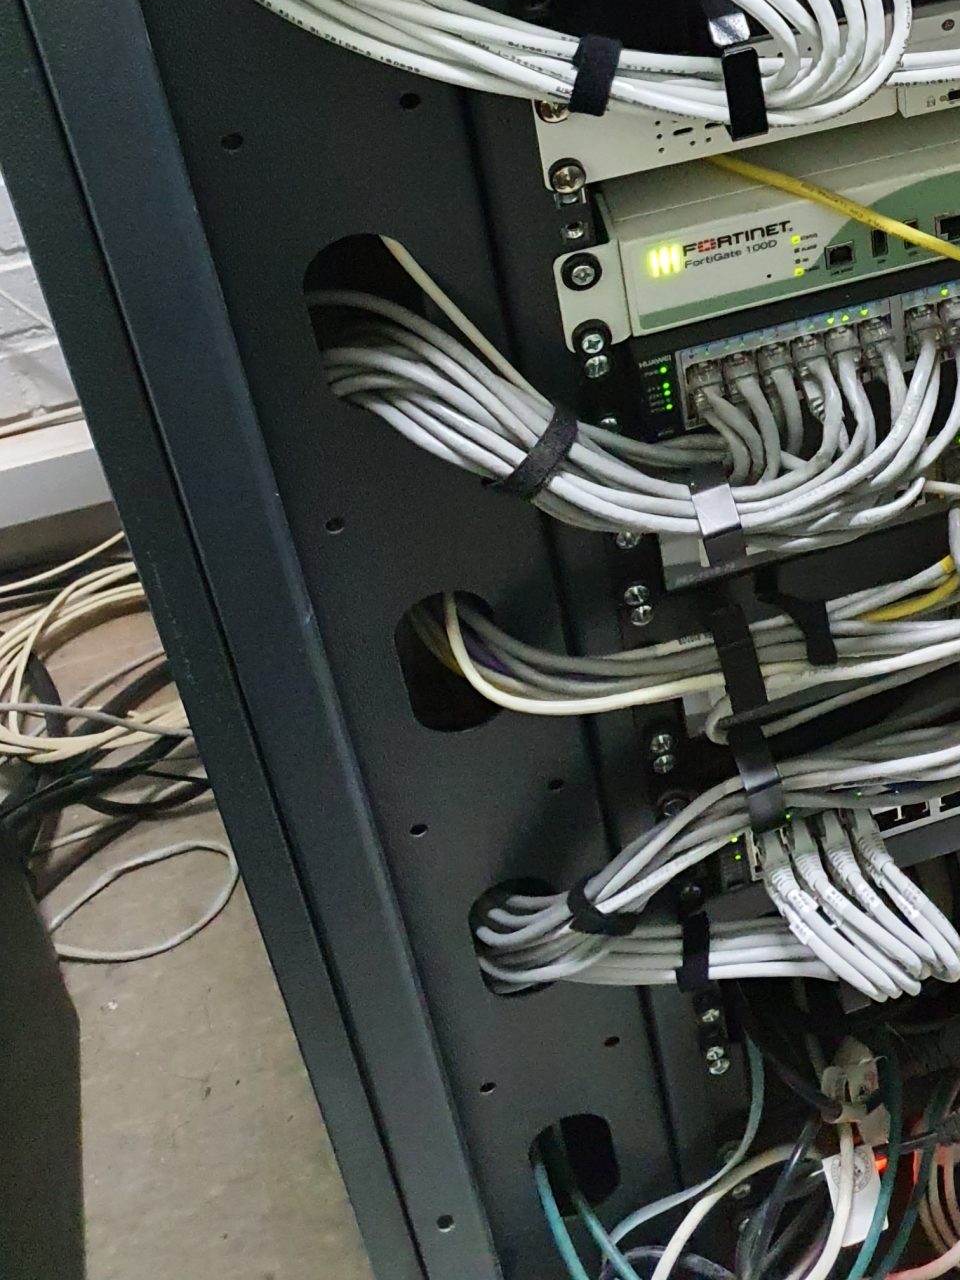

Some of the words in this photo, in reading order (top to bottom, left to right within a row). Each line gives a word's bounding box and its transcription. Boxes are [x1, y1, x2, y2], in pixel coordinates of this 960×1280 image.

[682, 219, 792, 257] FORTINET
[684, 246, 743, 269] FortiGate
[746, 238, 778, 256] 100D
[638, 354, 672, 370] HUAWEI
